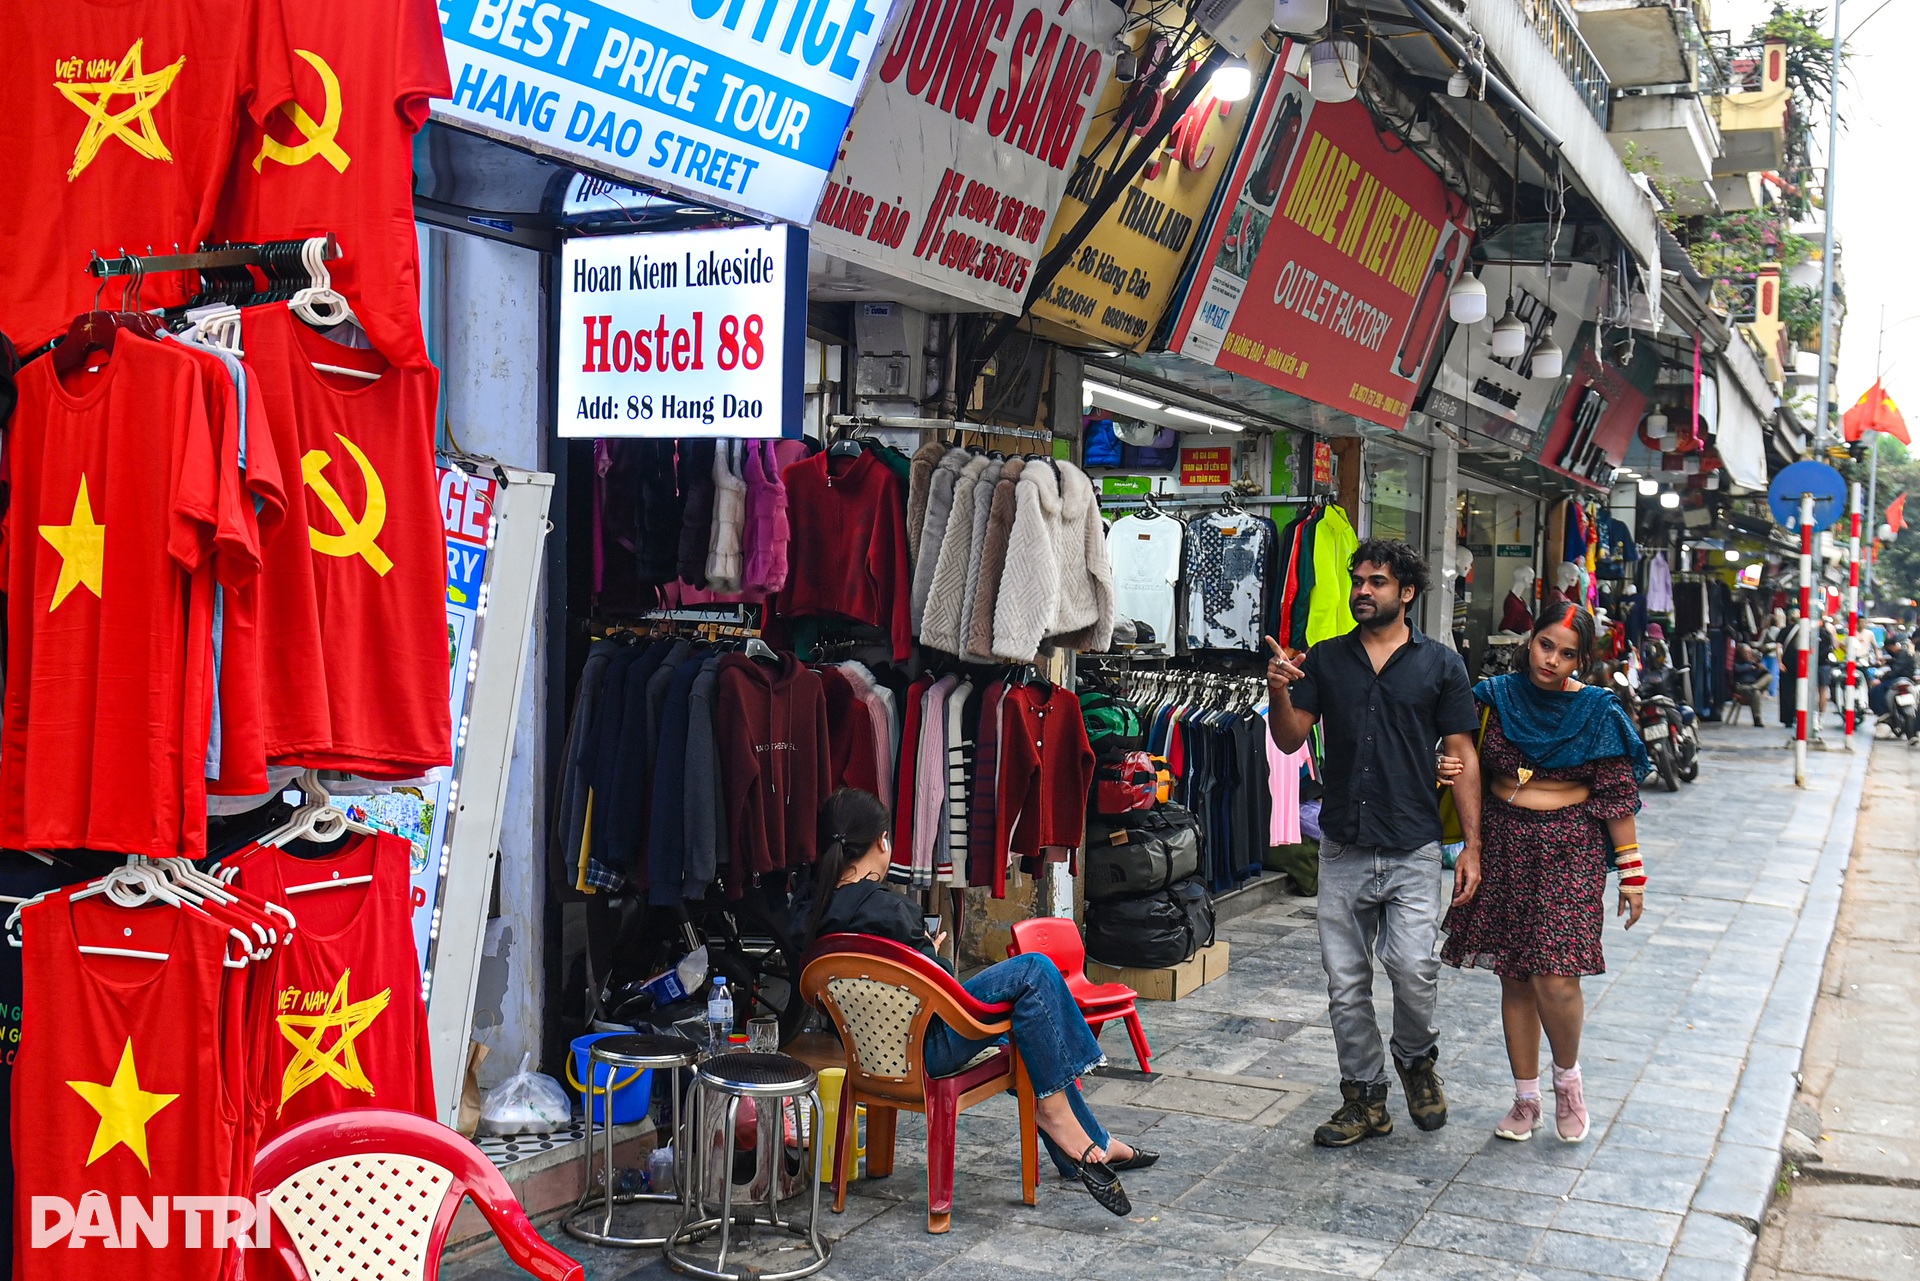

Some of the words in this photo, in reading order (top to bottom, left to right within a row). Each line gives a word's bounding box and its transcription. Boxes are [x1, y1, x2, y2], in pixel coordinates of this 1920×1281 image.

[56, 56, 83, 83] VIỆT
[86, 58, 116, 79] NAM
[468, 0, 590, 67] BEST
[593, 27, 709, 113] PRICE
[714, 73, 811, 150] TOUR
[452, 63, 560, 132] HANG
[565, 106, 642, 158] DAO
[648, 130, 759, 195] STREET
[816, 176, 874, 237] HÀNG
[959, 180, 1000, 227] 0904
[994, 194, 1024, 236] 168
[1016, 204, 1046, 244] 188
[1117, 184, 1192, 253] THAILAND
[1284, 130, 1360, 244] MADE
[1337, 171, 1380, 257] IN
[1358, 186, 1411, 276] VIET
[1388, 211, 1439, 298] NAM
[574, 258, 621, 292] Hoan
[629, 254, 677, 290] Kiem
[686, 248, 773, 287] Lakeside
[1039, 281, 1097, 318] 4.38248141
[1077, 246, 1099, 274] 86
[1093, 252, 1128, 295] Hàng
[1126, 267, 1151, 299] Đào
[1273, 260, 1341, 322] OUTLET
[1328, 291, 1393, 352] FACTORY
[582, 311, 703, 373] Hostel
[717, 314, 764, 371] 88
[577, 396, 619, 419] Add:
[626, 395, 653, 419] 88
[662, 395, 714, 424] Hang
[722, 394, 762, 418] Dao
[300, 990, 329, 1012] NAM
